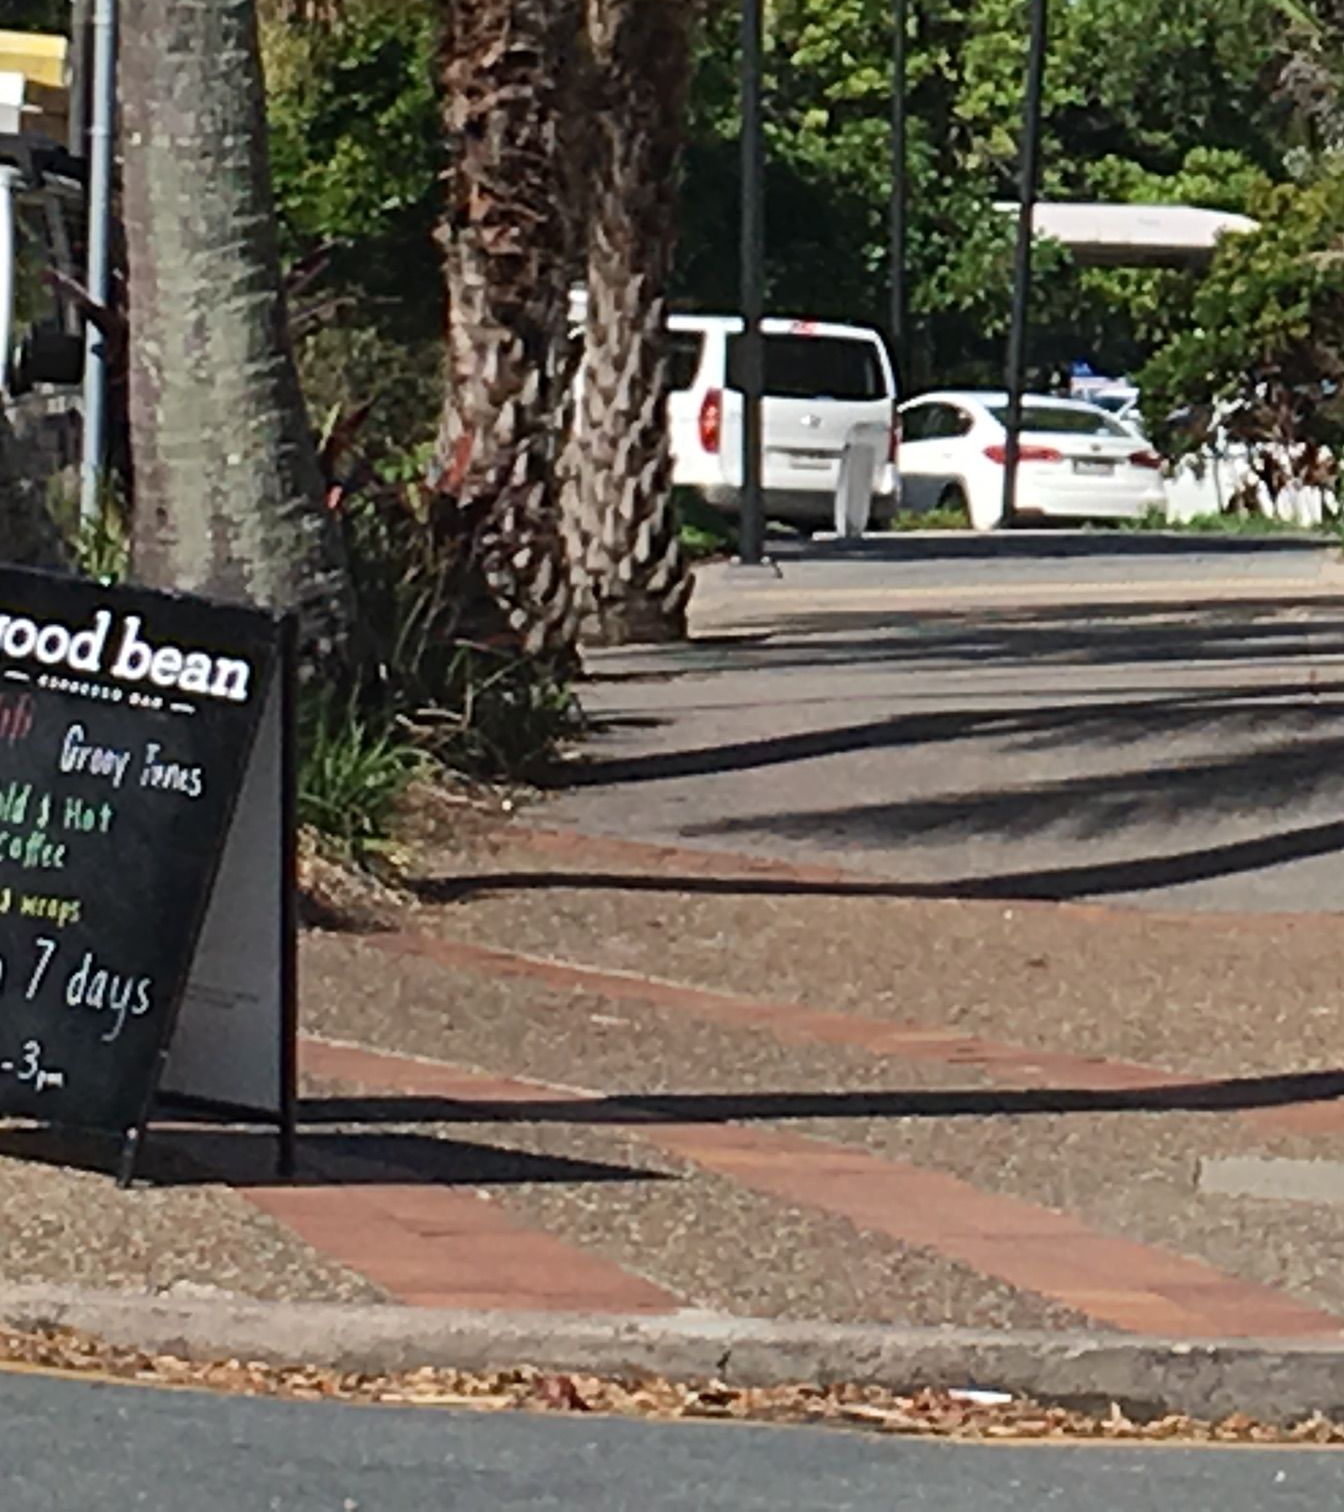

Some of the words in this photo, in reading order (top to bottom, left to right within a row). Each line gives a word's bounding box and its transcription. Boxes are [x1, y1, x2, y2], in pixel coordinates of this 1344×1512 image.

[0, 610, 112, 672] ood
[110, 615, 250, 702] bean
[63, 796, 114, 834] Hot
[25, 937, 56, 1001] 7
[66, 952, 152, 1042] days
